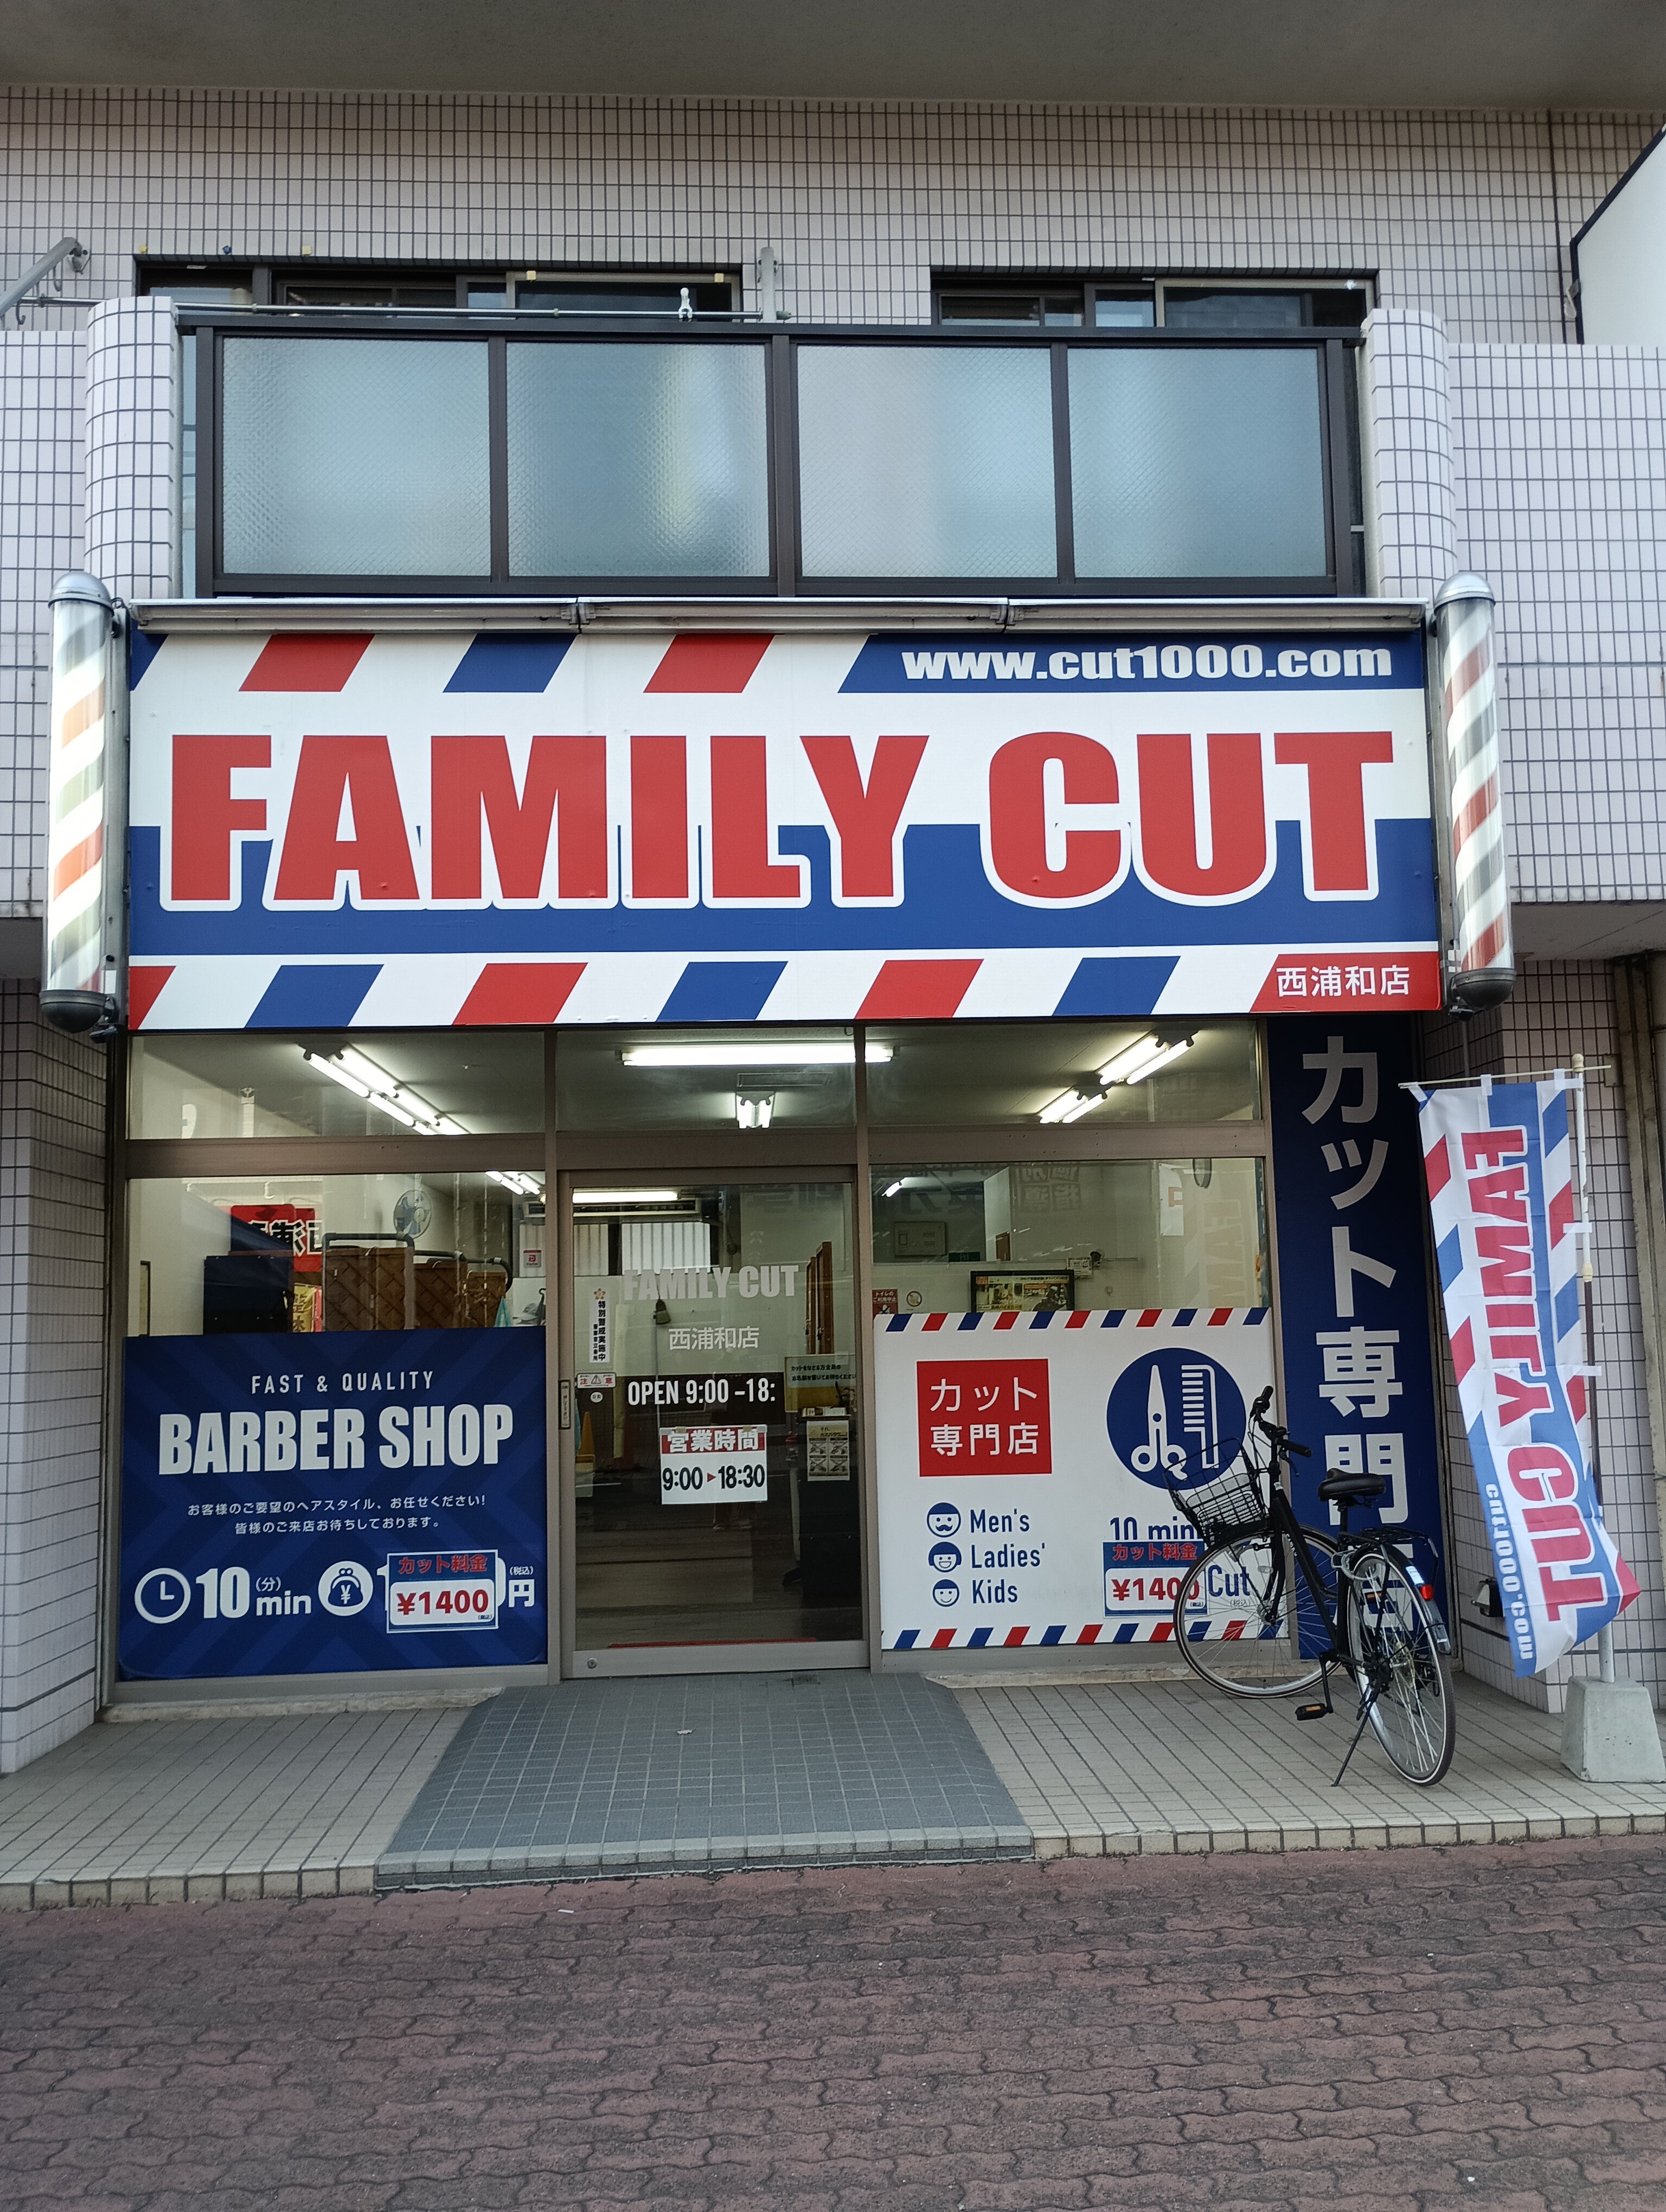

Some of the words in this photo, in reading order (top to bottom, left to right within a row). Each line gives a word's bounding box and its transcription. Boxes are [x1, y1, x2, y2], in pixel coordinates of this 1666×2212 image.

[902, 645, 1392, 680] www.cut1000.com
[171, 735, 929, 900] FAMILY
[989, 732, 1393, 898] CUT
[1276, 965, 1410, 998] 西浦和店
[624, 1267, 731, 1300] FAMILY
[739, 1265, 799, 1298] CUT
[669, 1326, 759, 1350] 西浦和店
[251, 1374, 304, 1394] FAST
[317, 1375, 328, 1392] &
[342, 1371, 434, 1391] QUALITY
[628, 1380, 679, 1406] OPEN
[686, 1378, 729, 1404] 9:00
[930, 1377, 1037, 1412] カット
[159, 1407, 365, 1475] BARBER
[379, 1404, 514, 1468] SHOP
[668, 1429, 759, 1452] 営業時間
[930, 1422, 1039, 1456] 専門店
[663, 1467, 703, 1491] 9:00
[718, 1464, 765, 1489] 18:30
[235, 1516, 440, 1535] 皆様のご来店お待ちしております。
[970, 1507, 1030, 1534] Men's
[1110, 1516, 1138, 1540] 10
[398, 1554, 489, 1574] カット料金
[971, 1542, 1046, 1569] Ladies'
[1112, 1543, 1198, 1561] カット料金
[196, 1567, 250, 1620] 10
[255, 1577, 282, 1592] (分)
[508, 1578, 535, 1608] 円
[972, 1579, 1018, 1604] Kids
[1208, 1565, 1250, 1597] Cut
[256, 1590, 311, 1616] min
[396, 1589, 489, 1615] ¥1400
